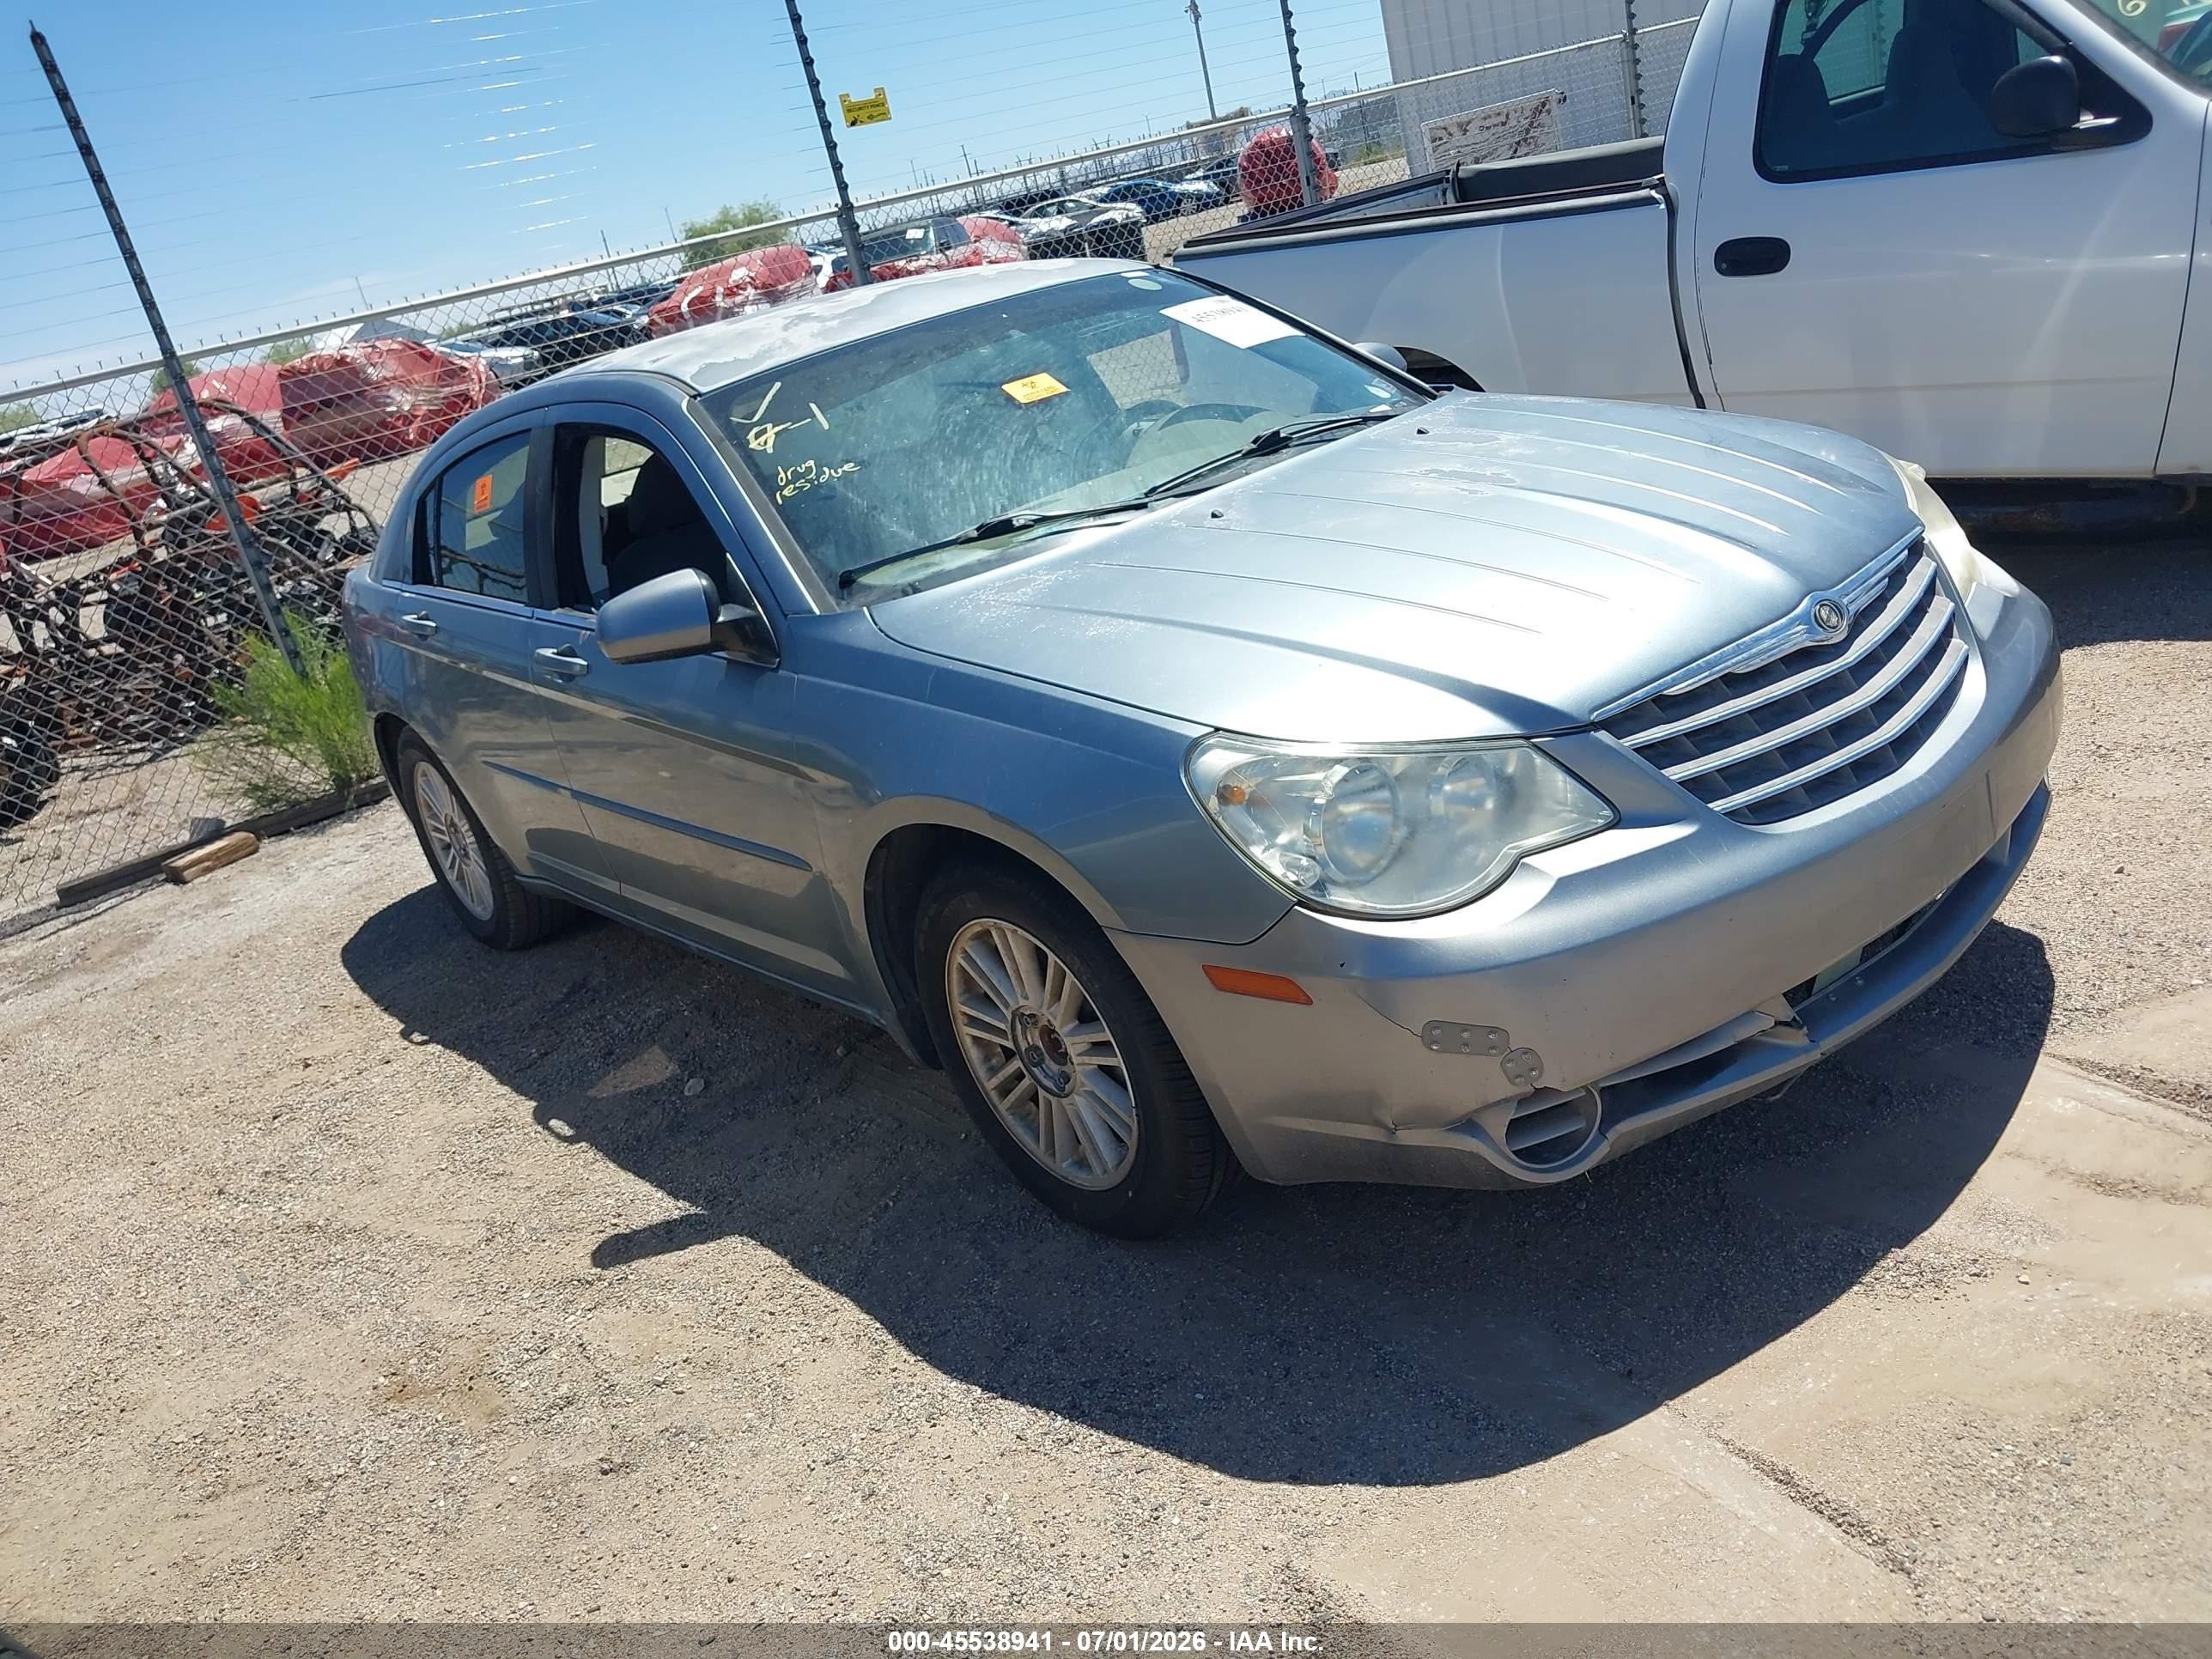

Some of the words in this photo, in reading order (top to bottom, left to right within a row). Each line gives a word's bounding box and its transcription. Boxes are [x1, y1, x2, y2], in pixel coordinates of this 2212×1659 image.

[846, 105, 870, 113] SECURITY
[775, 462, 861, 505] residue
[777, 460, 817, 486] drug
